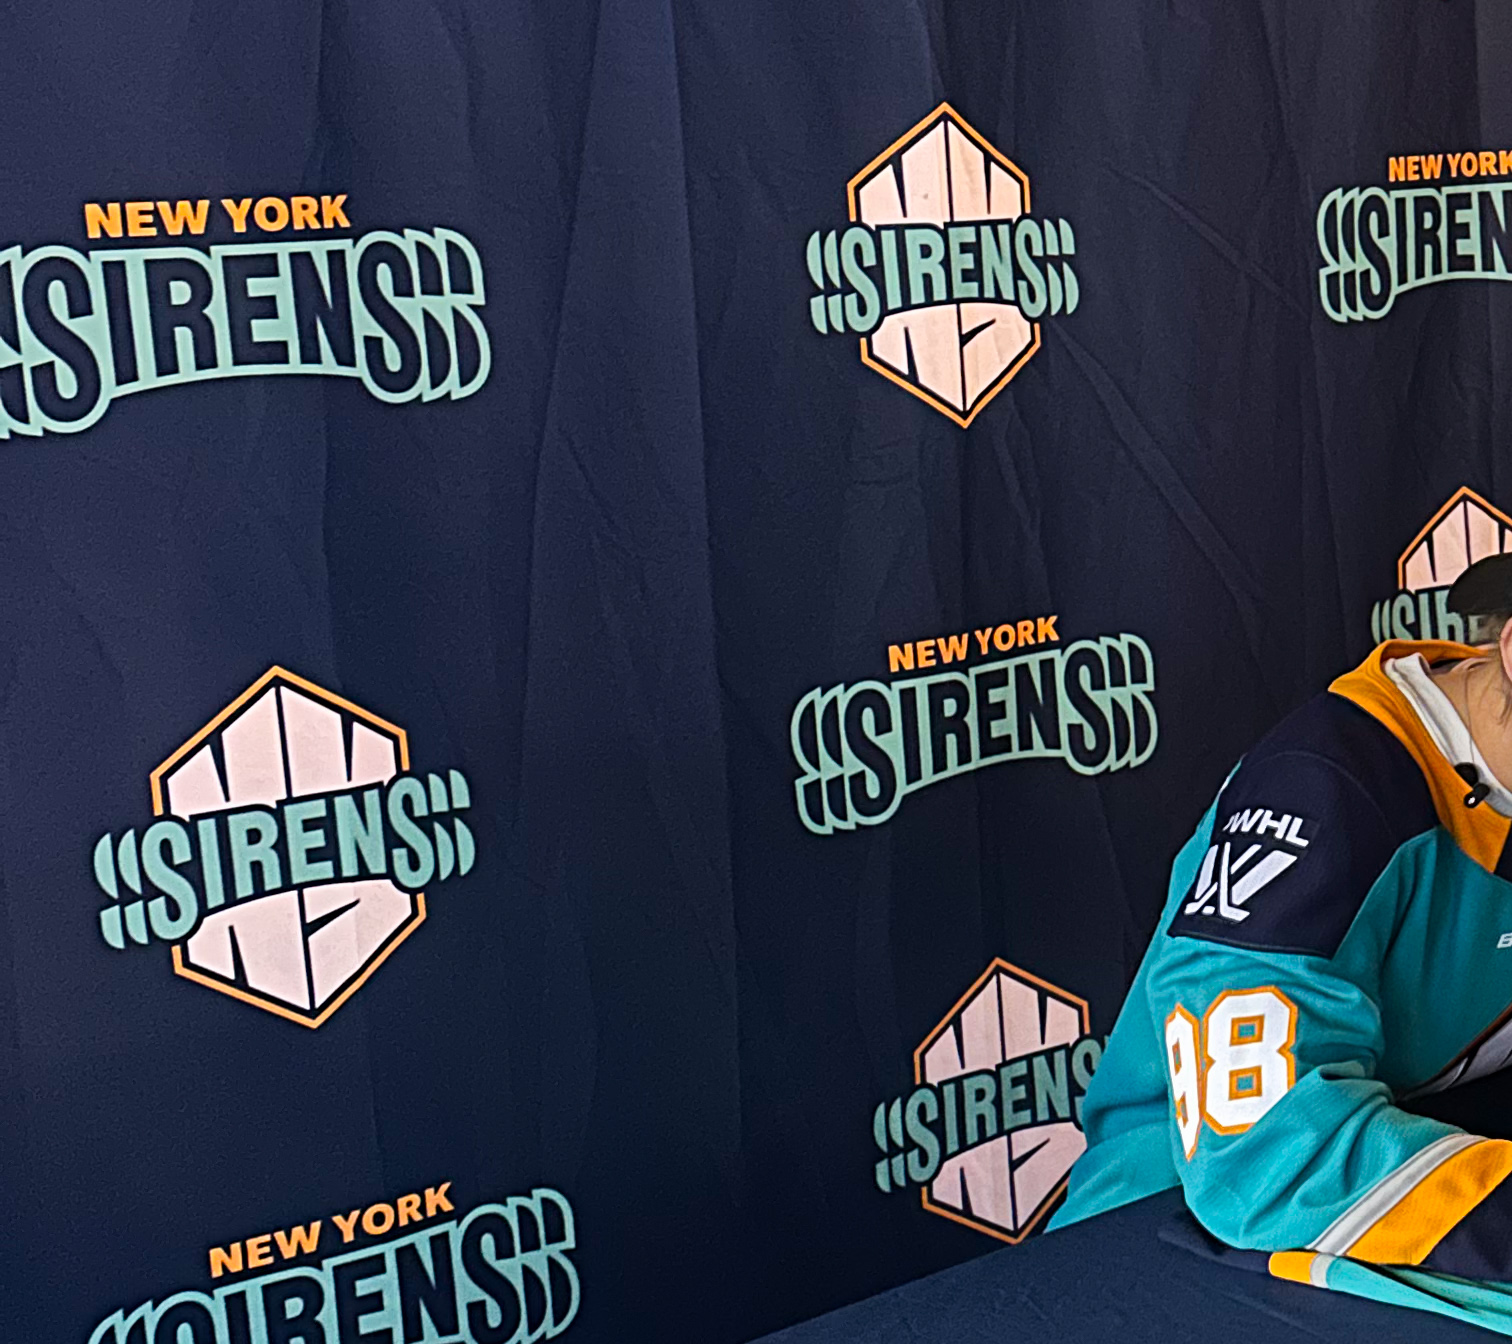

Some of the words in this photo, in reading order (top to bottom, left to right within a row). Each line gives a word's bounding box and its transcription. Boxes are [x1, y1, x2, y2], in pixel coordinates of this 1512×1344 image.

[84, 199, 210, 238] NEW
[221, 194, 350, 233] YORK
[1388, 154, 1443, 182] NEW
[838, 218, 1050, 333] SIRENS
[0, 227, 492, 438] SIRENS
[888, 633, 970, 672] NEW
[974, 615, 1059, 656] YORK
[790, 633, 1158, 834] SIRENS
[138, 775, 437, 941] SIRENS
[1222, 808, 1309, 848] WHL
[1164, 985, 1298, 1162] 98
[208, 1220, 322, 1278] NEW
[332, 1181, 455, 1244] YORK
